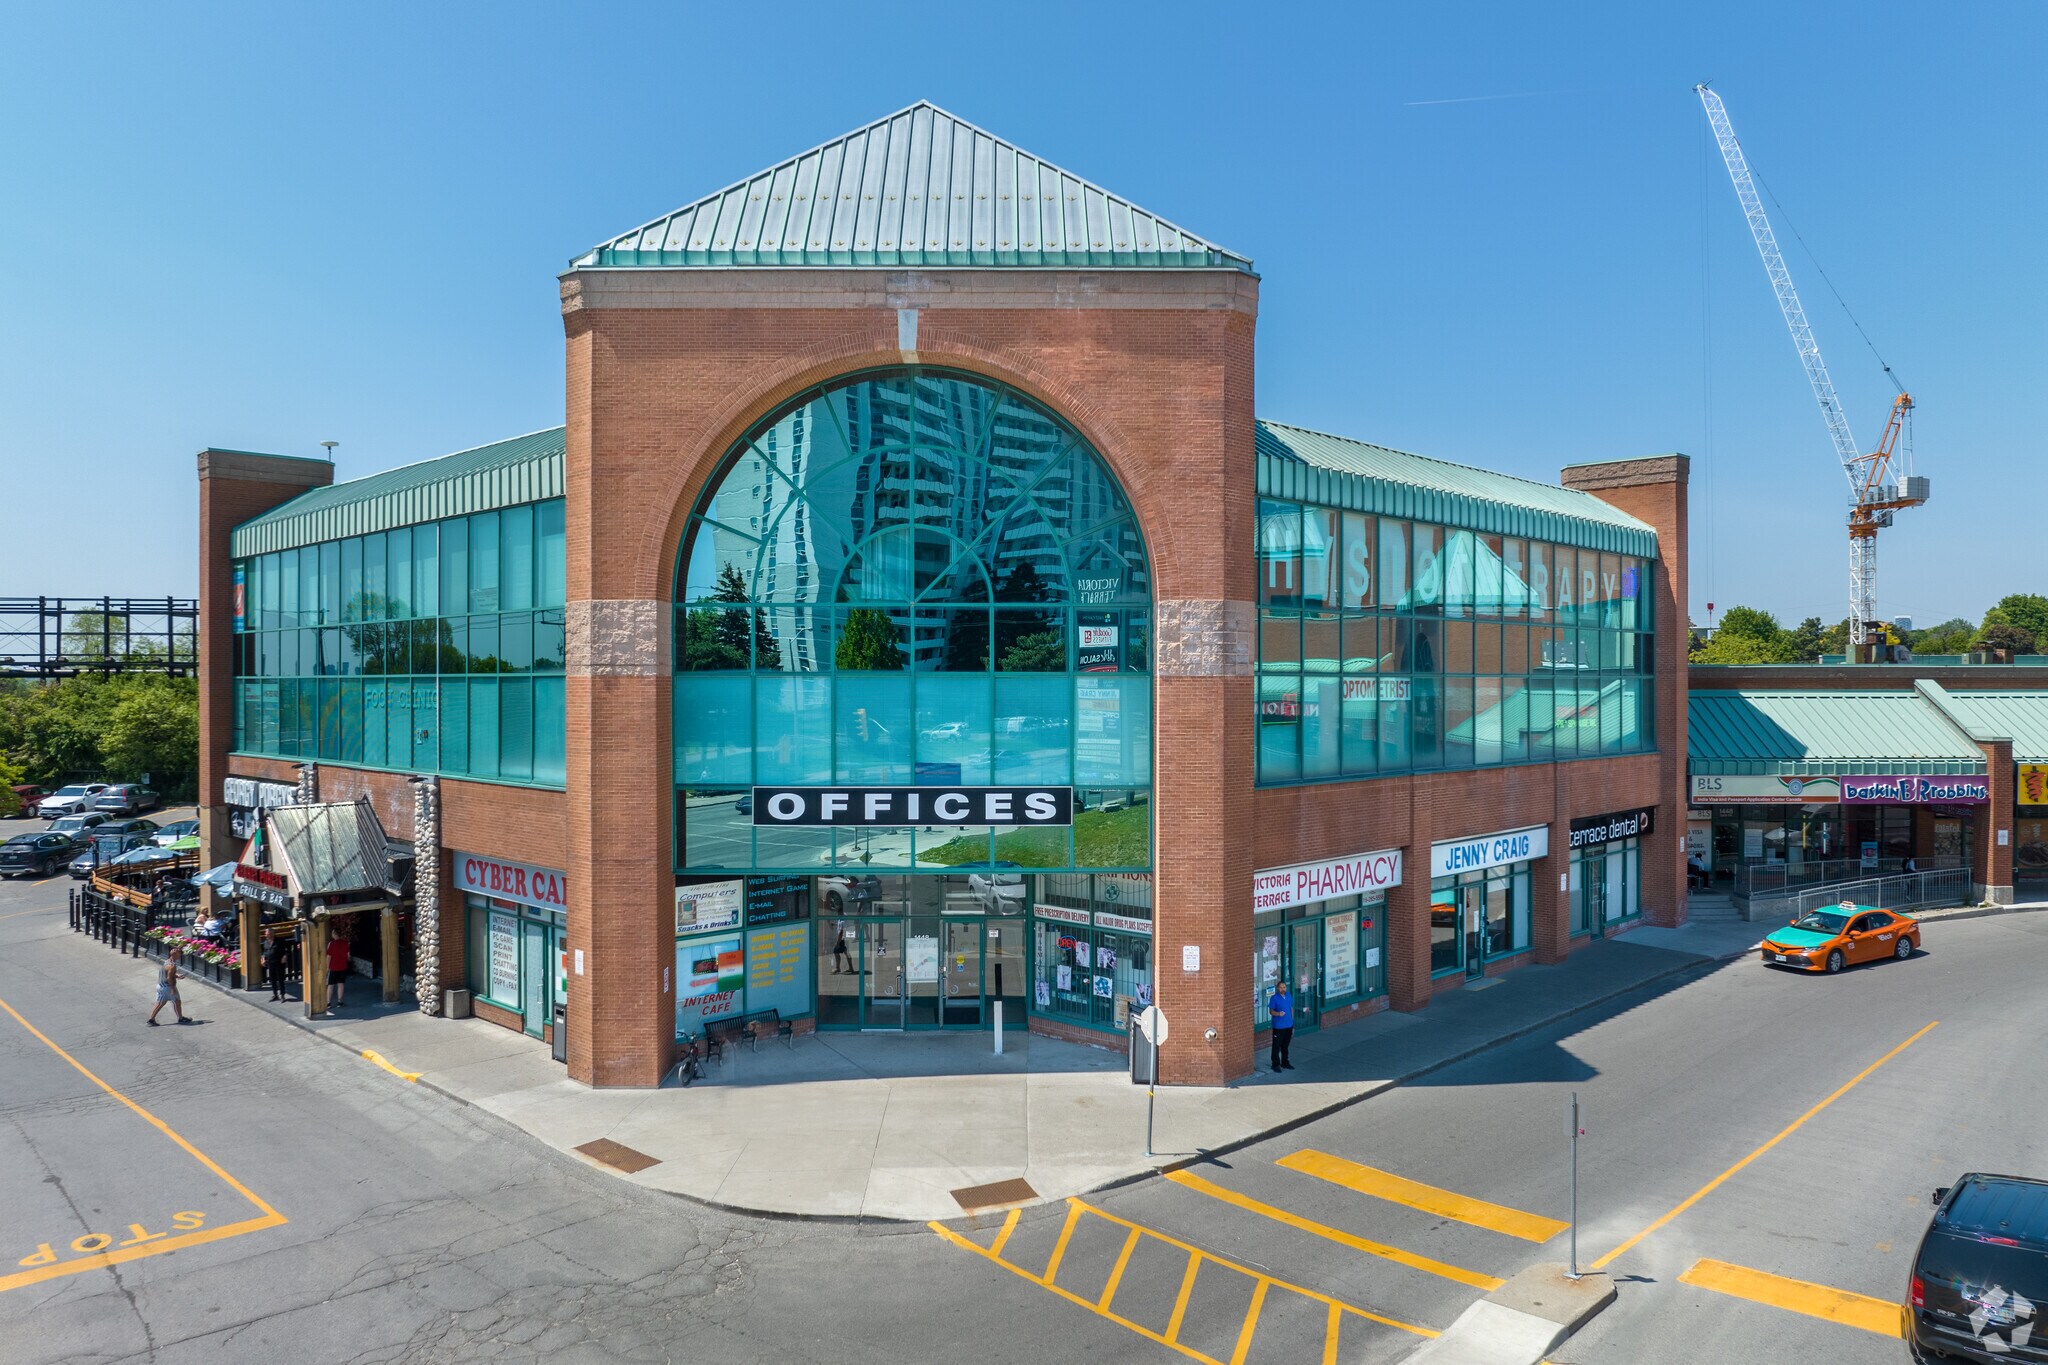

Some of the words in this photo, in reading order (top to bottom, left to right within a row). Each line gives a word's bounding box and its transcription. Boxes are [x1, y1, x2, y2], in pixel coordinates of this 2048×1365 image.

[1698, 778, 1722, 790] BLS
[1845, 783, 1899, 800] baskin
[1930, 784, 1986, 800] robbins
[767, 792, 1058, 821] OFFICES
[1569, 826, 1606, 848] terrace
[1609, 814, 1638, 839] dental
[1446, 842, 1489, 870] JENNY
[1494, 835, 1529, 862] CRAIG
[465, 858, 528, 898] CYBER
[1298, 855, 1398, 900] PHARMACY
[240, 885, 258, 898] GRILL
[270, 894, 283, 906] BAR
[680, 889, 736, 901] Computers
[1035, 906, 1044, 916] FREE
[1044, 908, 1070, 920] PRESCRIPTION
[1072, 912, 1089, 922] DELIVERY
[493, 916, 517, 928] INTERNET
[677, 924, 702, 933] Snacks
[710, 920, 732, 928] Drinks
[1102, 916, 1114, 926] MAJOR
[1114, 918, 1124, 928] DRUG
[1124, 920, 1136, 930] PLANS
[493, 924, 512, 935] E-MAIL
[500, 934, 513, 944] GAME
[1056, 938, 1076, 950] OPEN
[493, 942, 512, 952] SCAN
[493, 950, 512, 960] PRINT
[493, 958, 517, 972] CHATTING
[499, 969, 517, 982] BURNING
[493, 976, 506, 988] COPY
[508, 982, 517, 990] FAX
[684, 990, 736, 1008] INTERNET
[702, 1002, 730, 1016] CAFE
[18, 1211, 206, 1267] STOP
